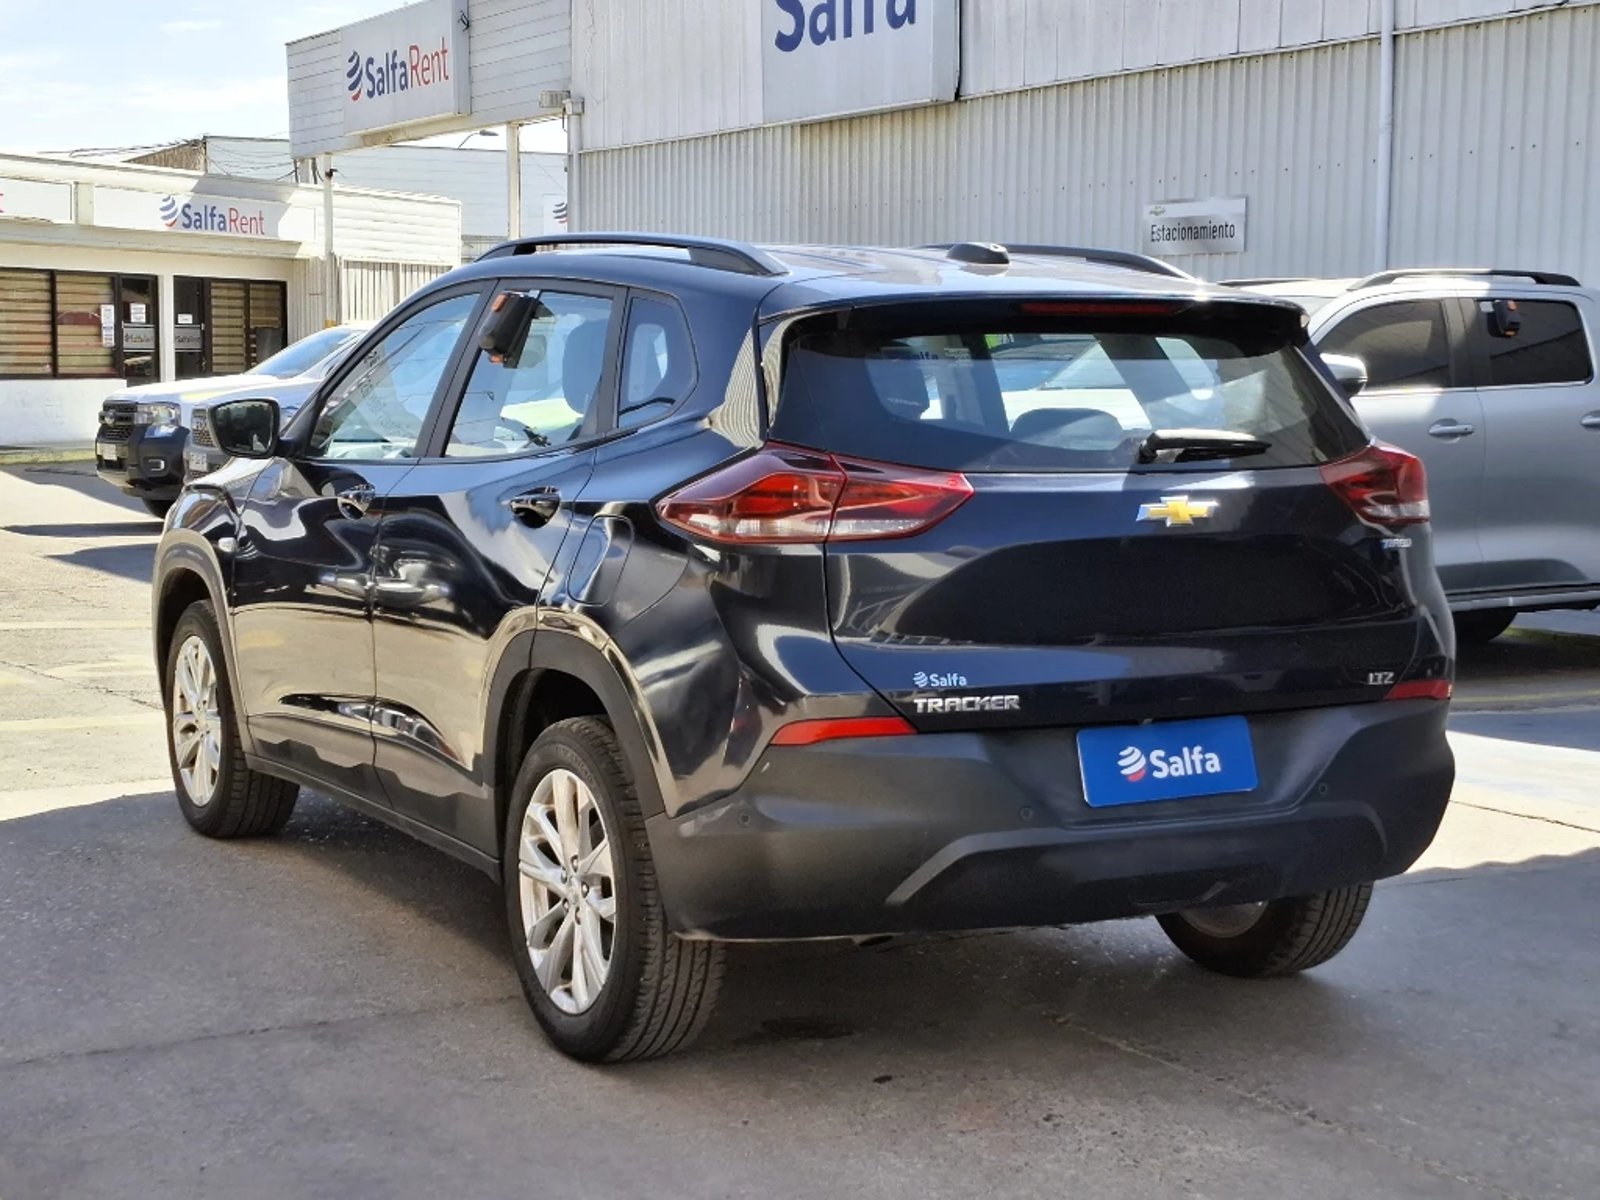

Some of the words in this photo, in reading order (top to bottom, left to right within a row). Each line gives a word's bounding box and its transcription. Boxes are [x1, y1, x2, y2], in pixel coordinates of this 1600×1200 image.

[365, 36, 449, 99] SalfaRent
[181, 203, 265, 235] SalfaRent
[1151, 220, 1235, 242] Estacionamiento
[929, 673, 967, 687] Salfa
[1369, 671, 1395, 685] LTZ
[913, 695, 1020, 713] TRACKER
[1149, 745, 1221, 779] Salfa
